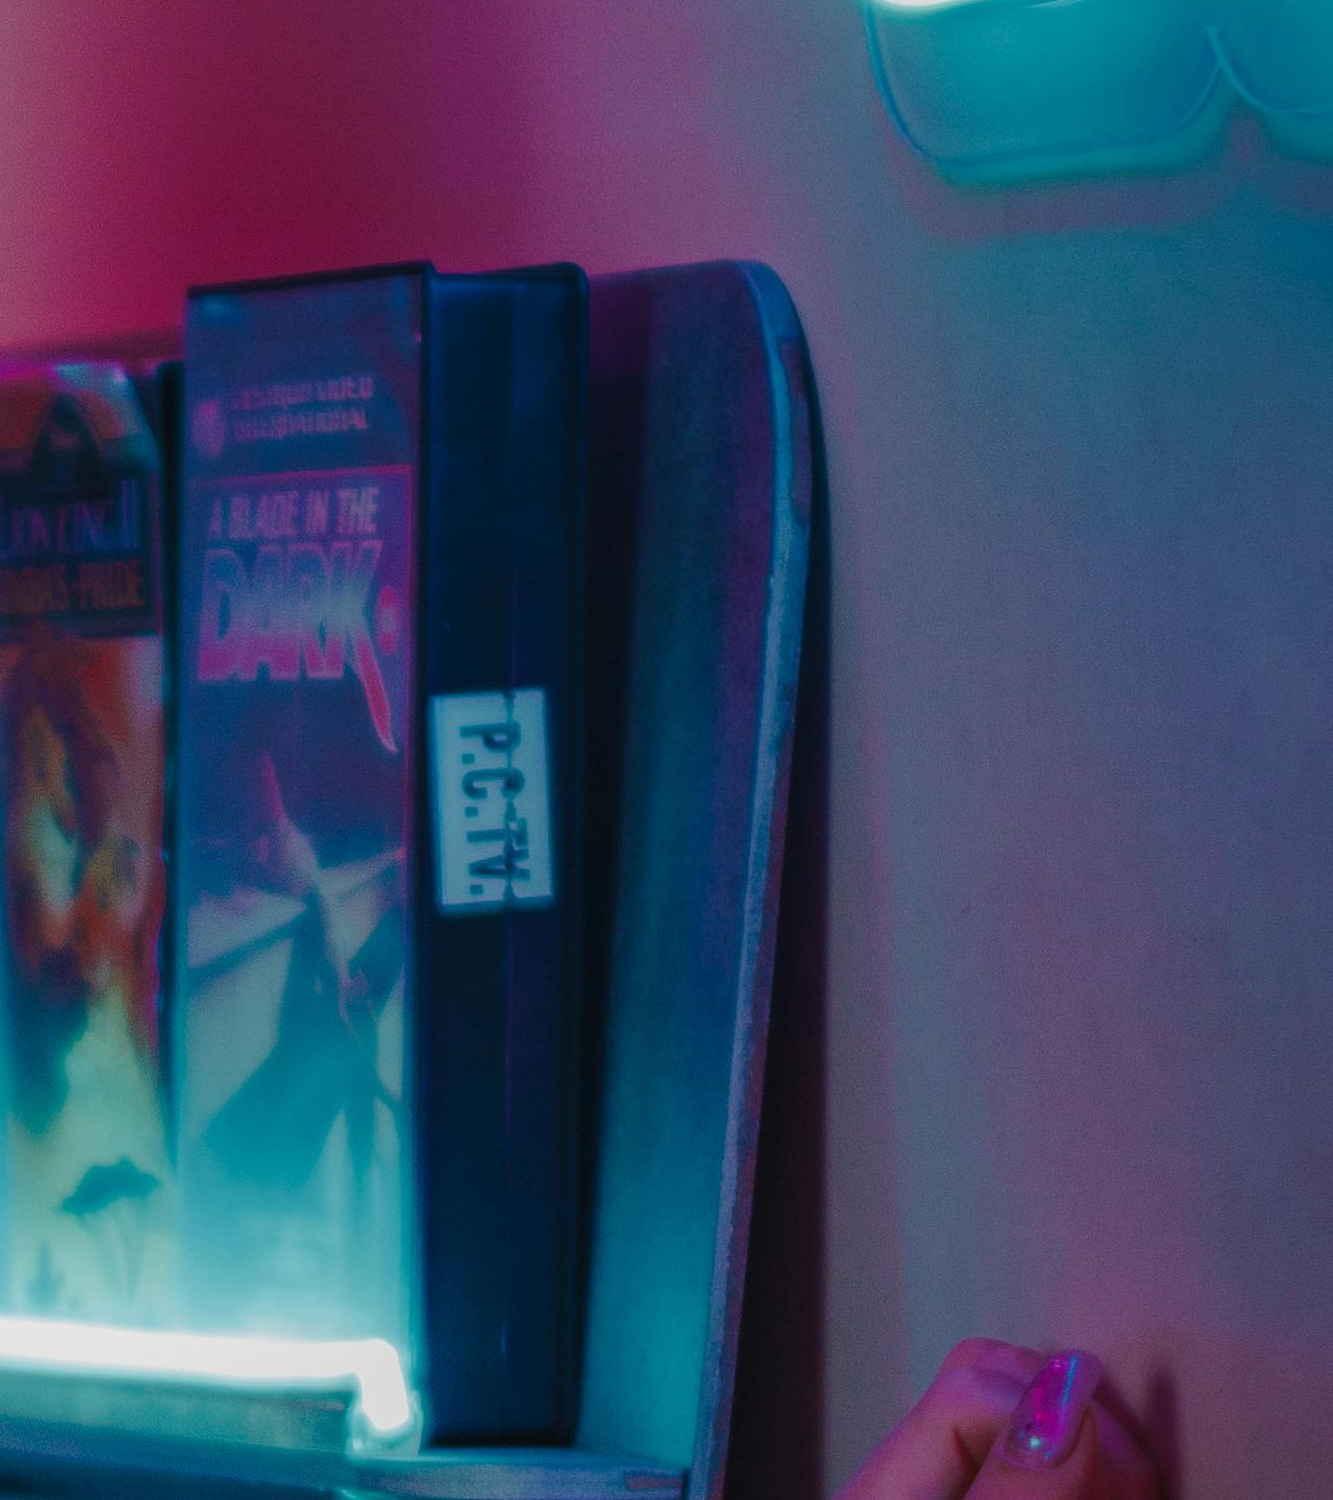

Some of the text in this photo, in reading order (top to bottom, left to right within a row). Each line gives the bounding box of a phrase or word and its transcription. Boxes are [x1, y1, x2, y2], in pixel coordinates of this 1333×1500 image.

[208, 485, 380, 540] A BLADE IN THE
[196, 539, 391, 730] DARK
